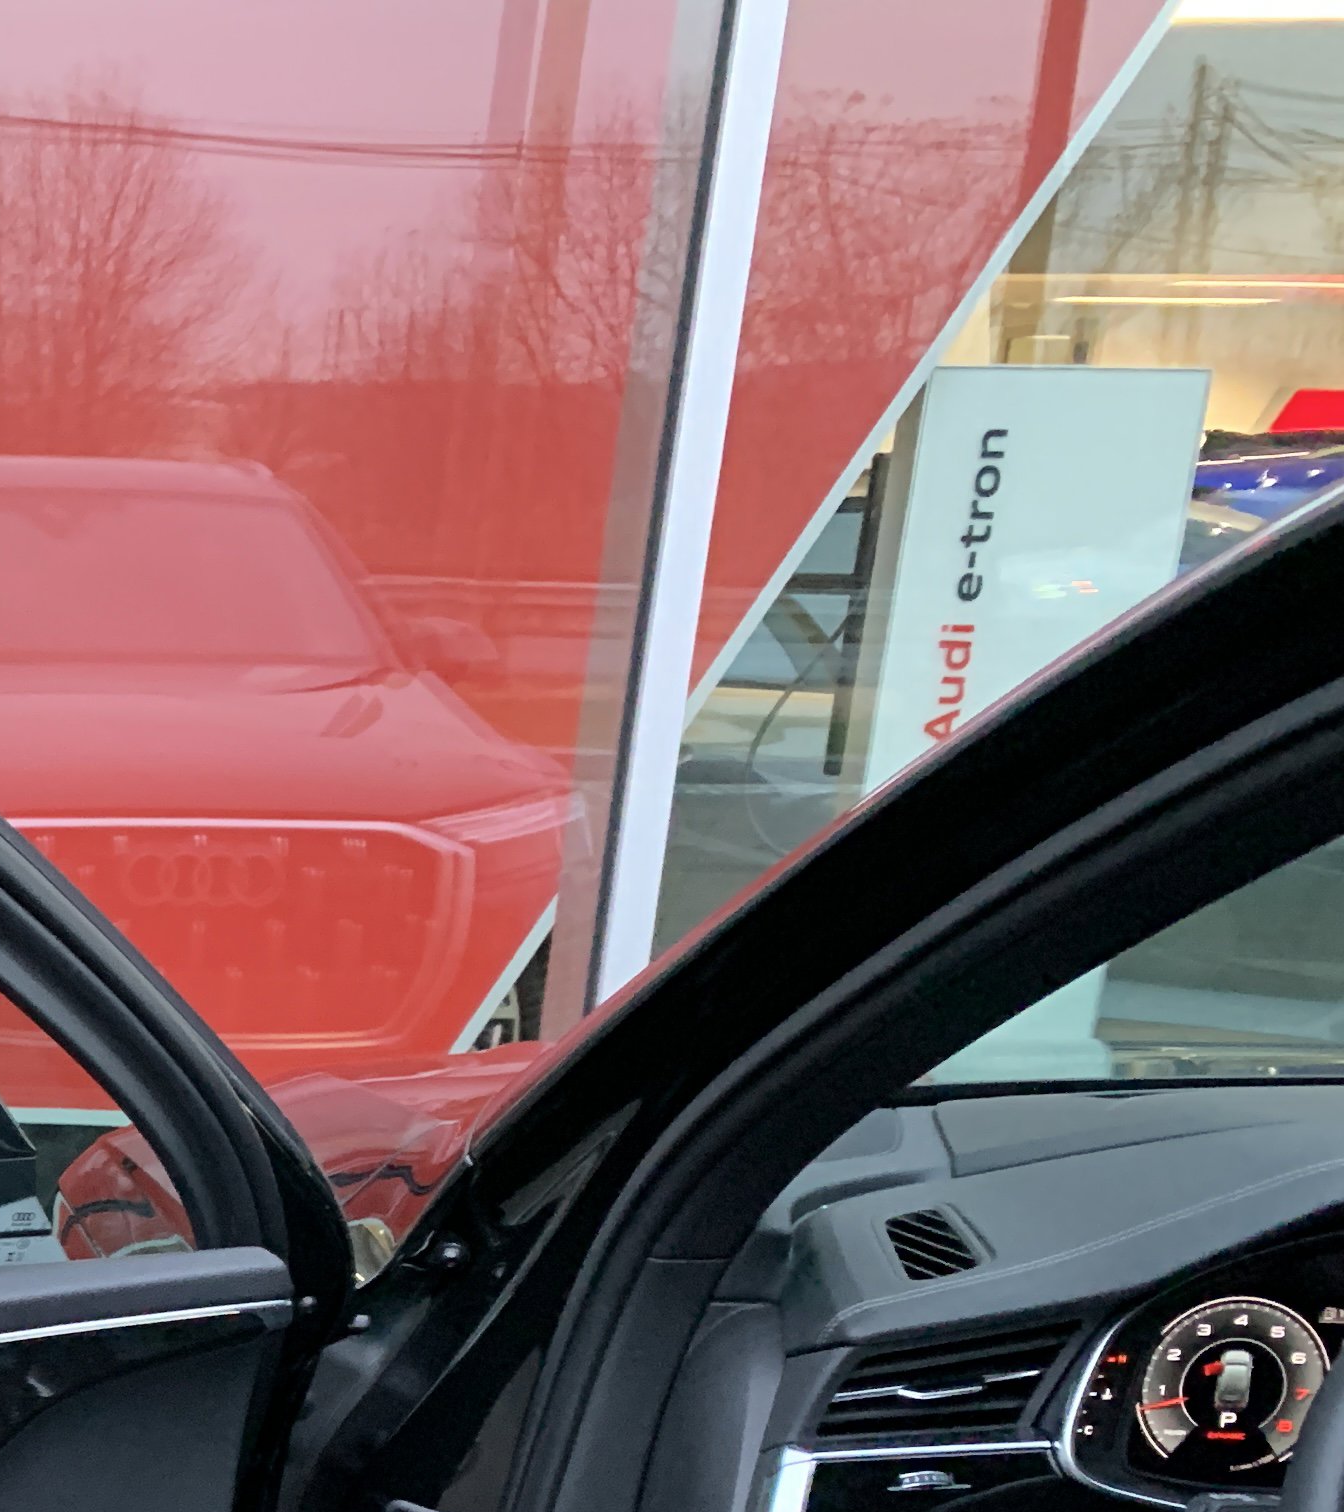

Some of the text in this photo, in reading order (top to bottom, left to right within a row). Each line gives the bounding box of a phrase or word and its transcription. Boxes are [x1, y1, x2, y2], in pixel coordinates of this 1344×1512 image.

[923, 427, 1009, 744] Audi e-tron
[1233, 1313, 1249, 1327] 4
[1195, 1323, 1212, 1337] 3
[1269, 1325, 1286, 1339] 5
[1166, 1348, 1182, 1362] 2
[1290, 1351, 1307, 1365] 6
[1158, 1384, 1166, 1396] 1
[1295, 1388, 1310, 1400] 7
[1219, 1411, 1238, 1428] P
[1276, 1418, 1293, 1433] 8
[1083, 1424, 1094, 1436] C
